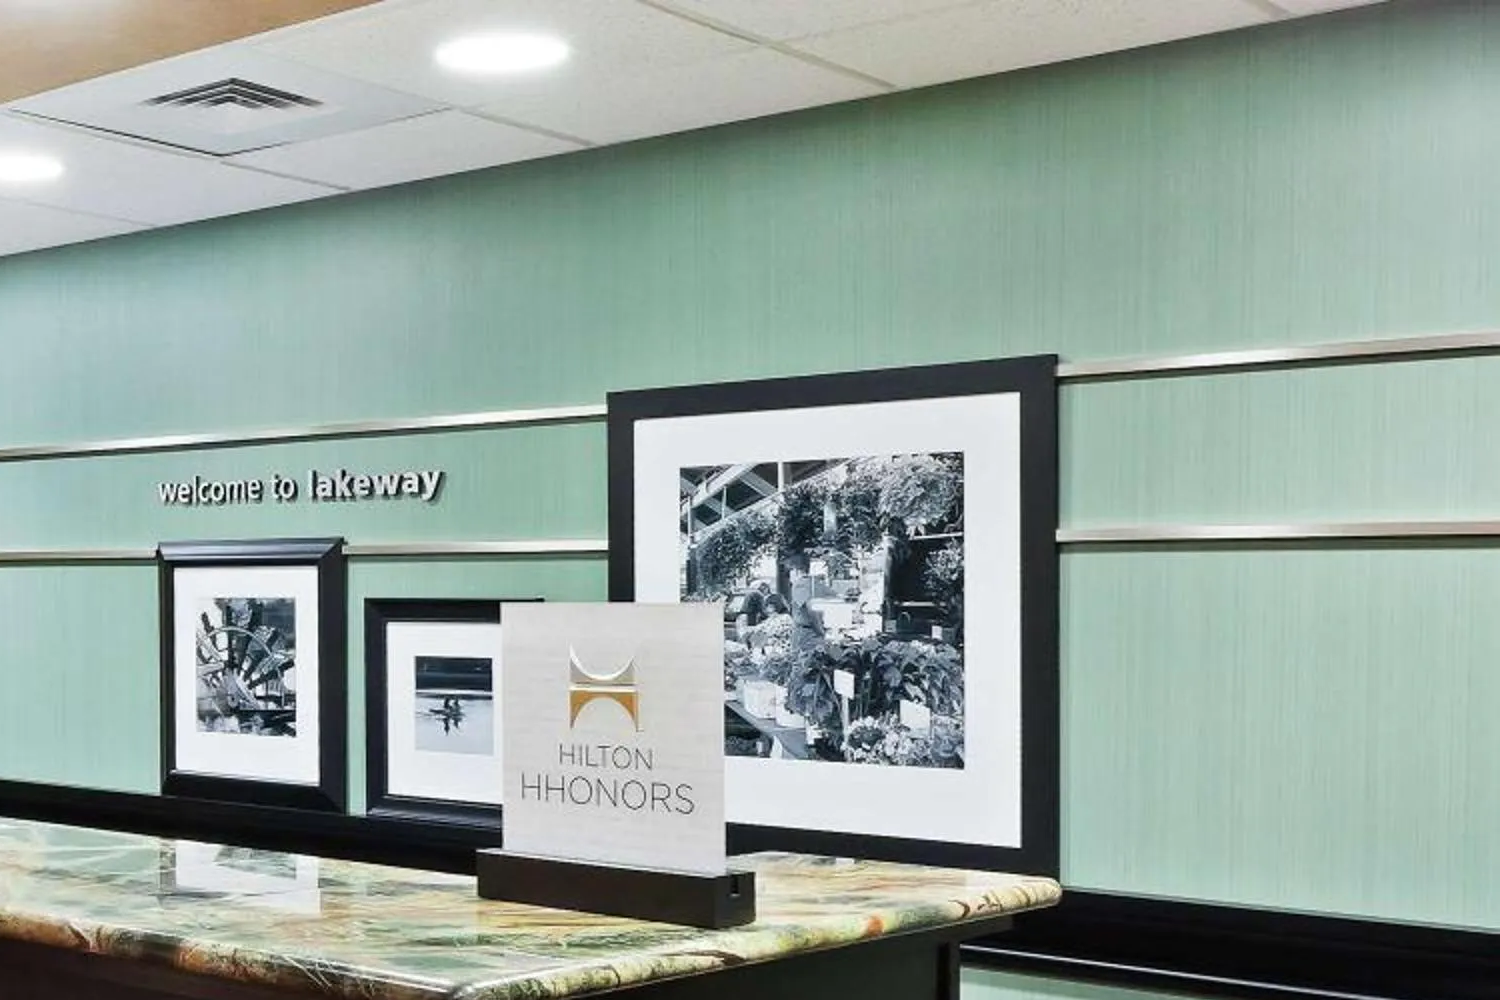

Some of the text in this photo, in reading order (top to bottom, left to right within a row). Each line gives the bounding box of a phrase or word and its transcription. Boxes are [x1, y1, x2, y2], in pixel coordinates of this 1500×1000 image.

[159, 469, 445, 504] welcome to lakeway
[558, 743, 653, 771] HILTON
[521, 773, 695, 815] HHONORS
